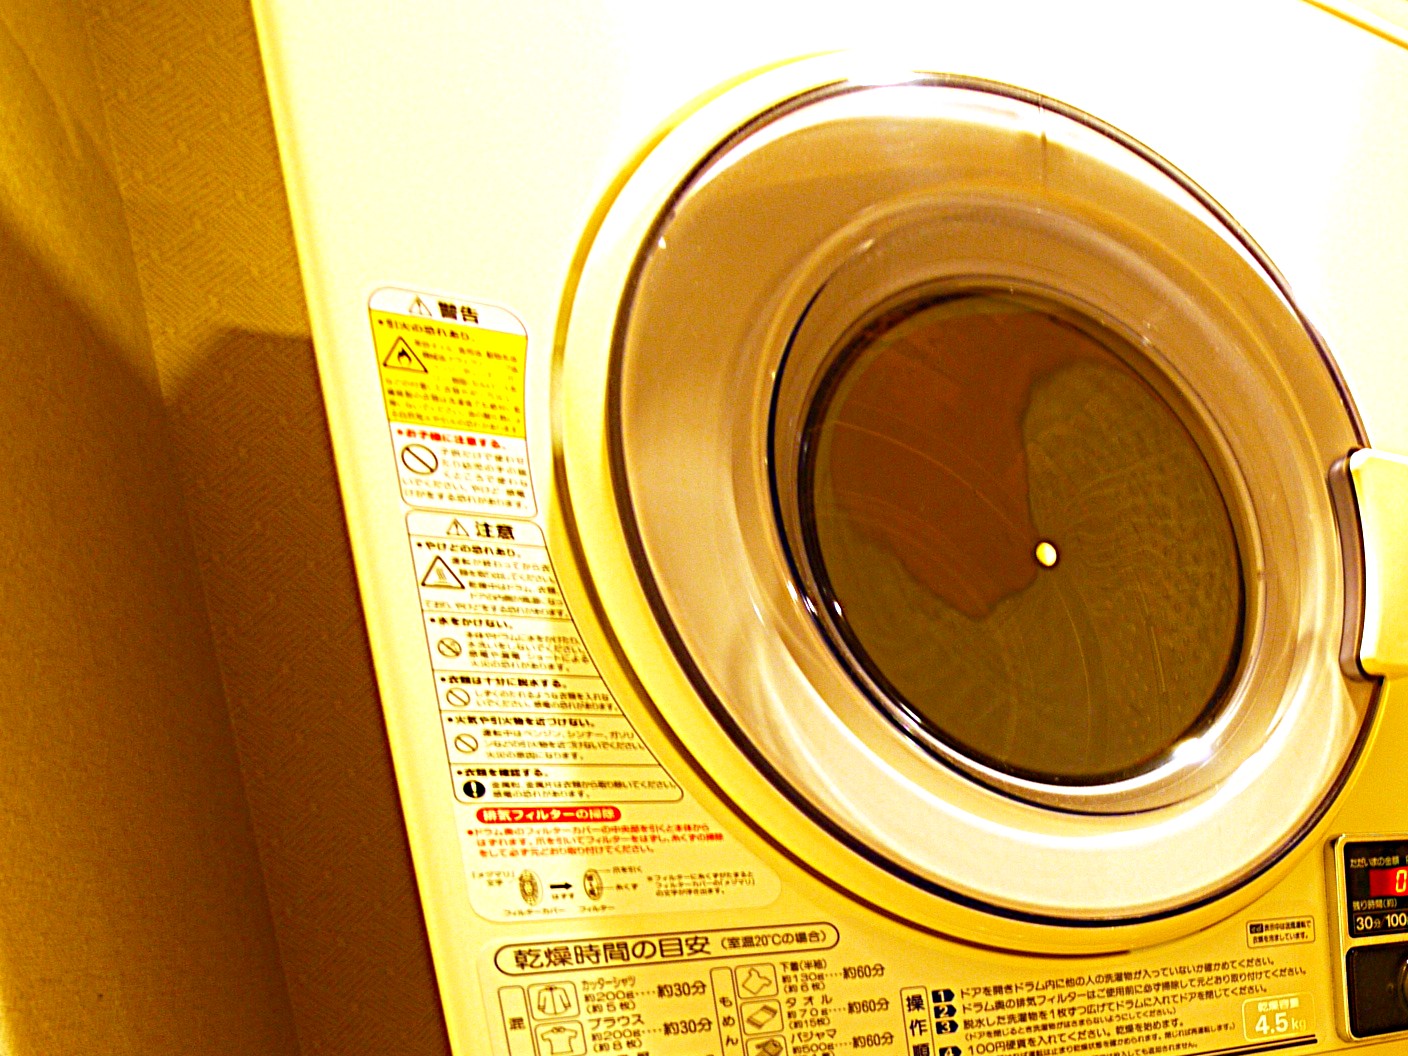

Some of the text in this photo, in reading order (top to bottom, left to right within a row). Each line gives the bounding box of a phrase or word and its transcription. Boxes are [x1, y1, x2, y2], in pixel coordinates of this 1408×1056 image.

[438, 301, 480, 324] 警告
[475, 521, 515, 540] 注意
[483, 808, 616, 822] 排気フィルターの掃除
[1395, 869, 1408, 893] 0
[514, 936, 711, 970] 乾燥時間の目安
[842, 963, 886, 980] 約60分
[582, 976, 636, 991] カッターシャツ
[657, 981, 707, 999] 約30分
[847, 997, 890, 1014] 約60分
[588, 1014, 645, 1030] ブラウス
[664, 1017, 713, 1036] 約30分
[791, 1028, 837, 1044] パジャマ
[852, 1031, 894, 1049] 約60分
